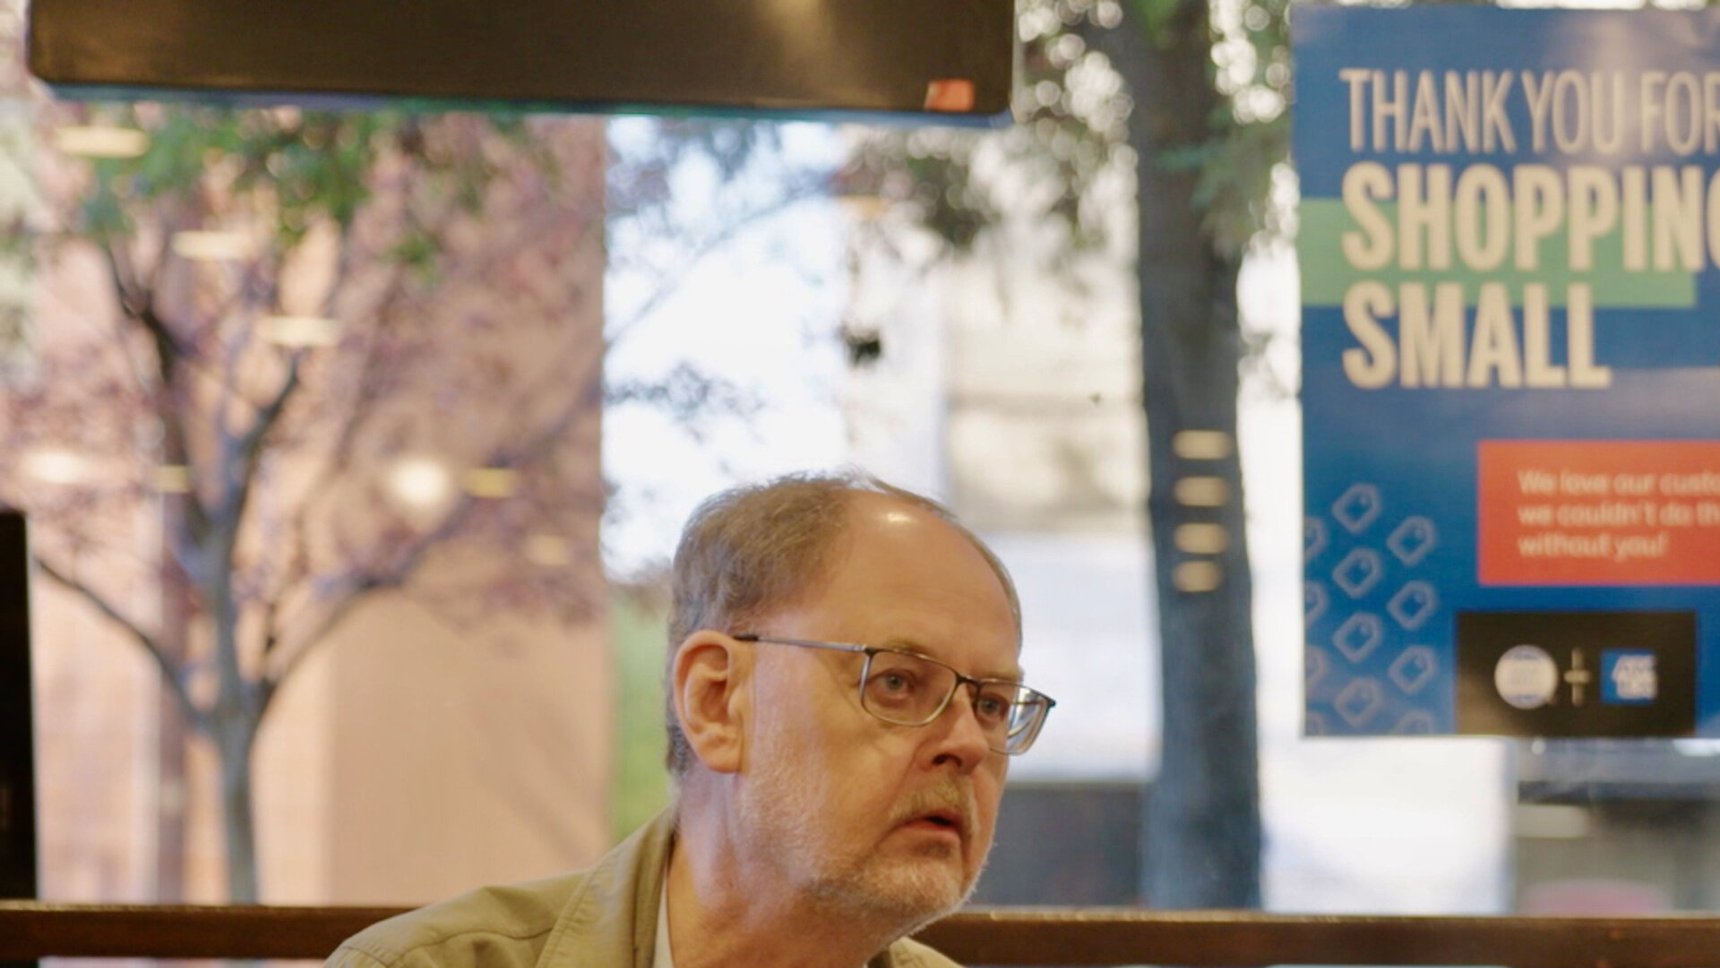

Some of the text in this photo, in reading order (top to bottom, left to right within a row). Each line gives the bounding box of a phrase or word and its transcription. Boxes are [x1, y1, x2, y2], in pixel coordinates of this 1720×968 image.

[1338, 69, 1516, 154] THANK
[1521, 70, 1624, 155] YOU
[1341, 280, 1612, 389] SMALL
[1518, 470, 1554, 495] We
[1560, 469, 1607, 495] love
[1612, 472, 1654, 495] our
[1518, 505, 1551, 526] we
[1659, 502, 1692, 526] do
[1518, 531, 1668, 563] without you!
